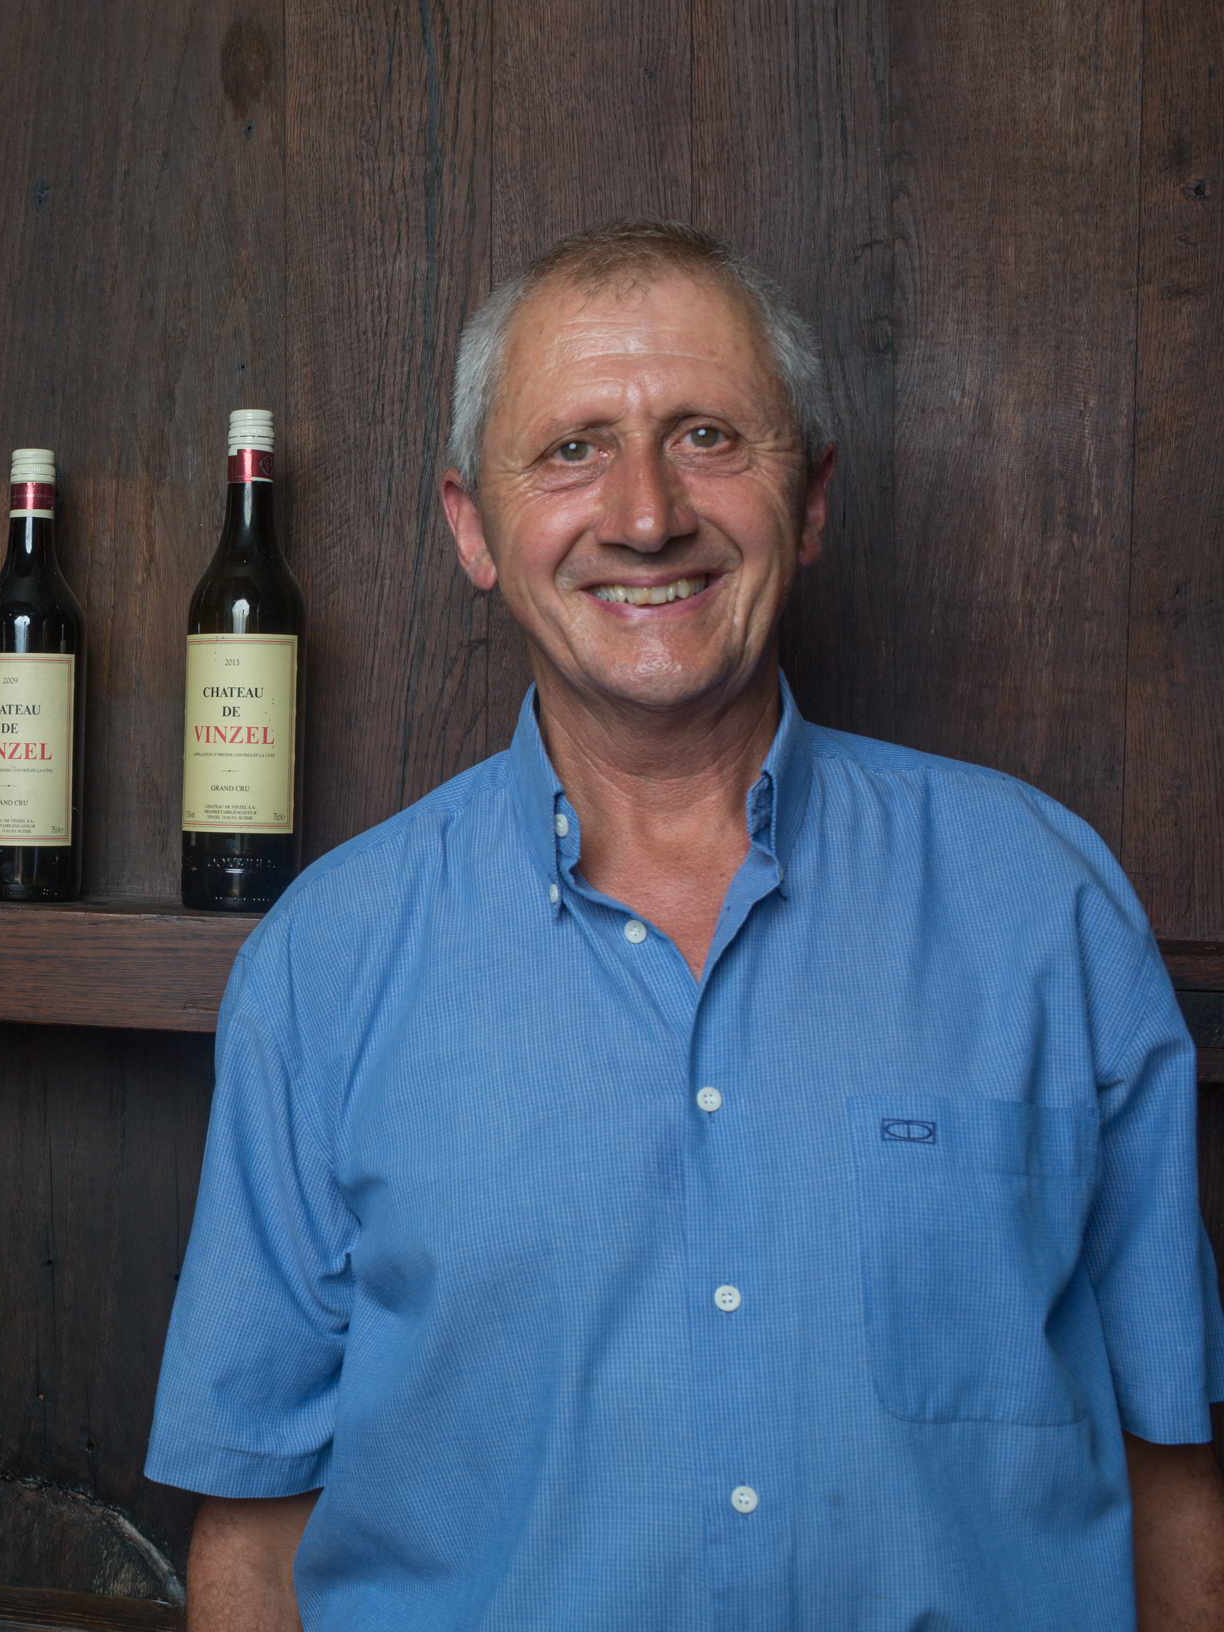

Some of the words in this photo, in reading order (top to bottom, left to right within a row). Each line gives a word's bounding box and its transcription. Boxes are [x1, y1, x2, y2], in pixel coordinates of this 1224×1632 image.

[203, 687, 264, 698] CHATEAU
[222, 706, 240, 717] DE
[1, 723, 18, 734] DE
[194, 726, 275, 745] VINZEL
